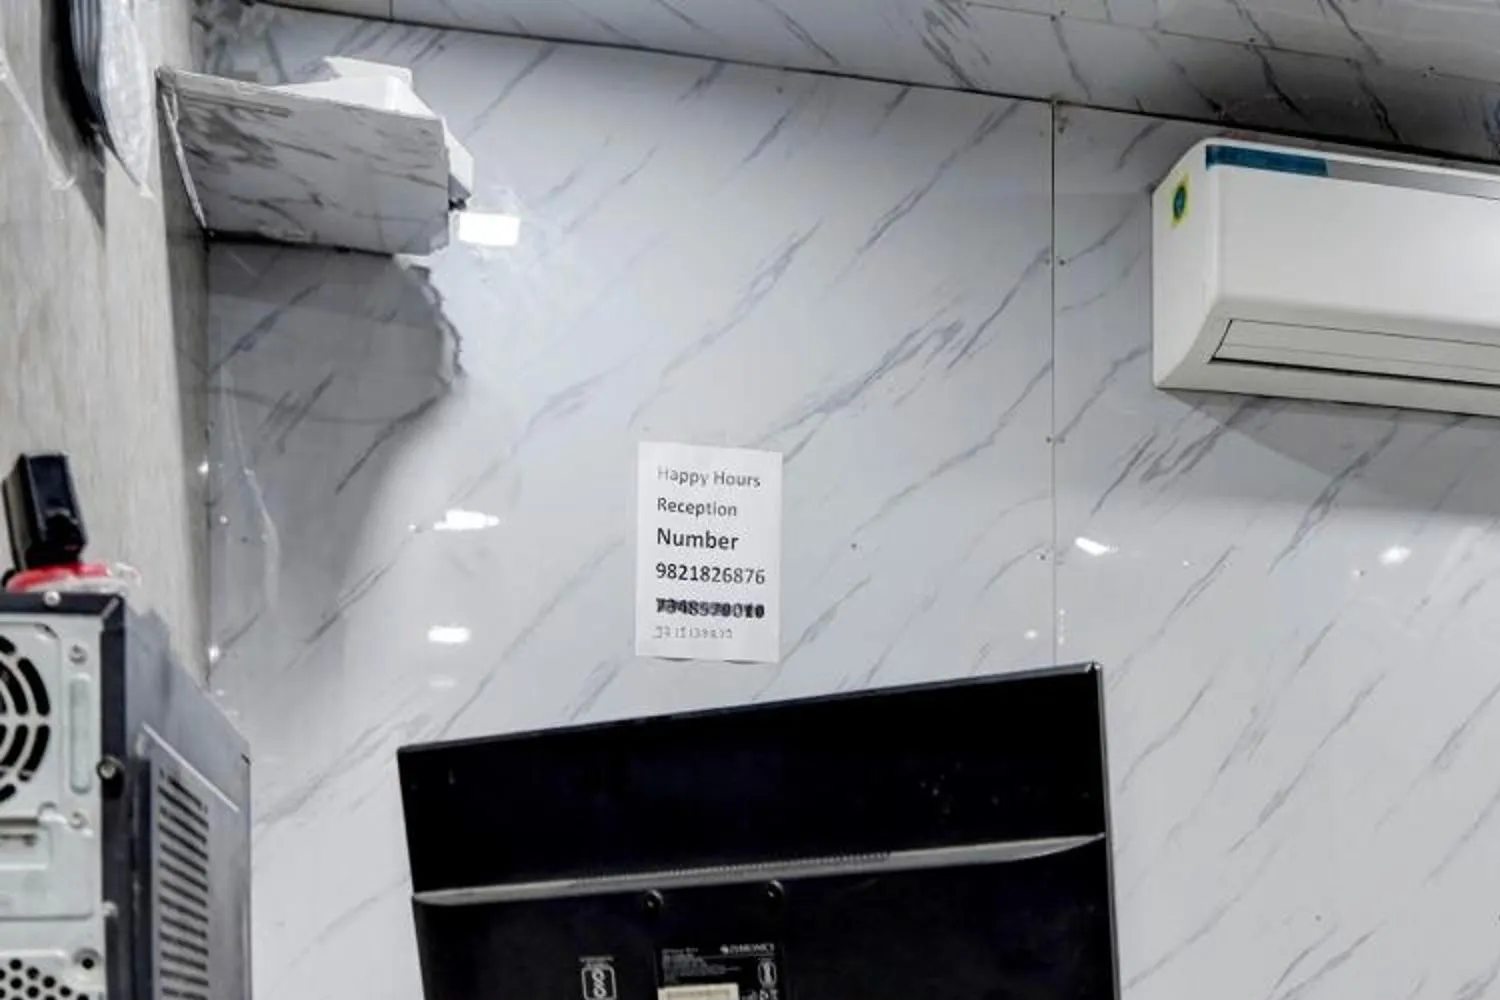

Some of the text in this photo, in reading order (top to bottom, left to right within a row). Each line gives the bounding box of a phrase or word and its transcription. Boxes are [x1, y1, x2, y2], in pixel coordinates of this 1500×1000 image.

[657, 465, 761, 488] Happy Hours
[656, 497, 738, 518] Reception
[656, 527, 739, 550] Number
[655, 562, 765, 585] 9821826876
